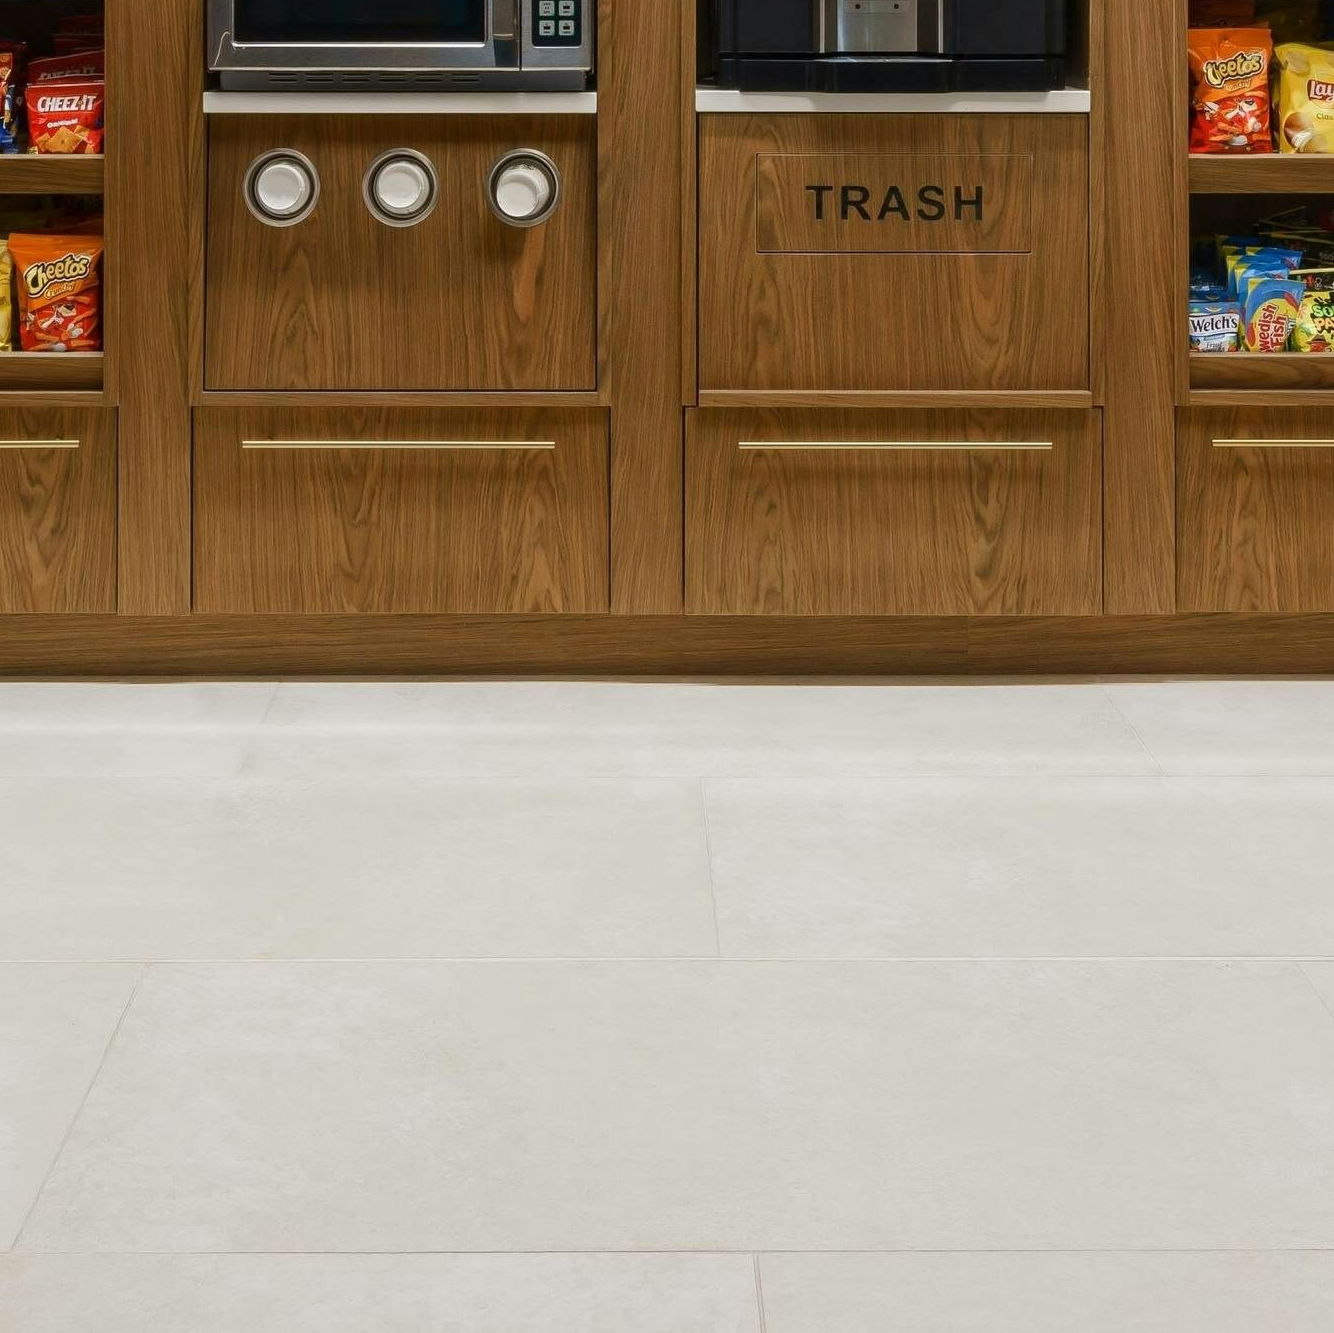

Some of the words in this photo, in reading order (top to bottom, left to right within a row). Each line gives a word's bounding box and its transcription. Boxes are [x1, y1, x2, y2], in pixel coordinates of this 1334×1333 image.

[805, 185, 983, 221] TRASH
[24, 253, 91, 295] Cheetos
[1190, 316, 1238, 333] Welch's
[1271, 314, 1287, 347] Fish
